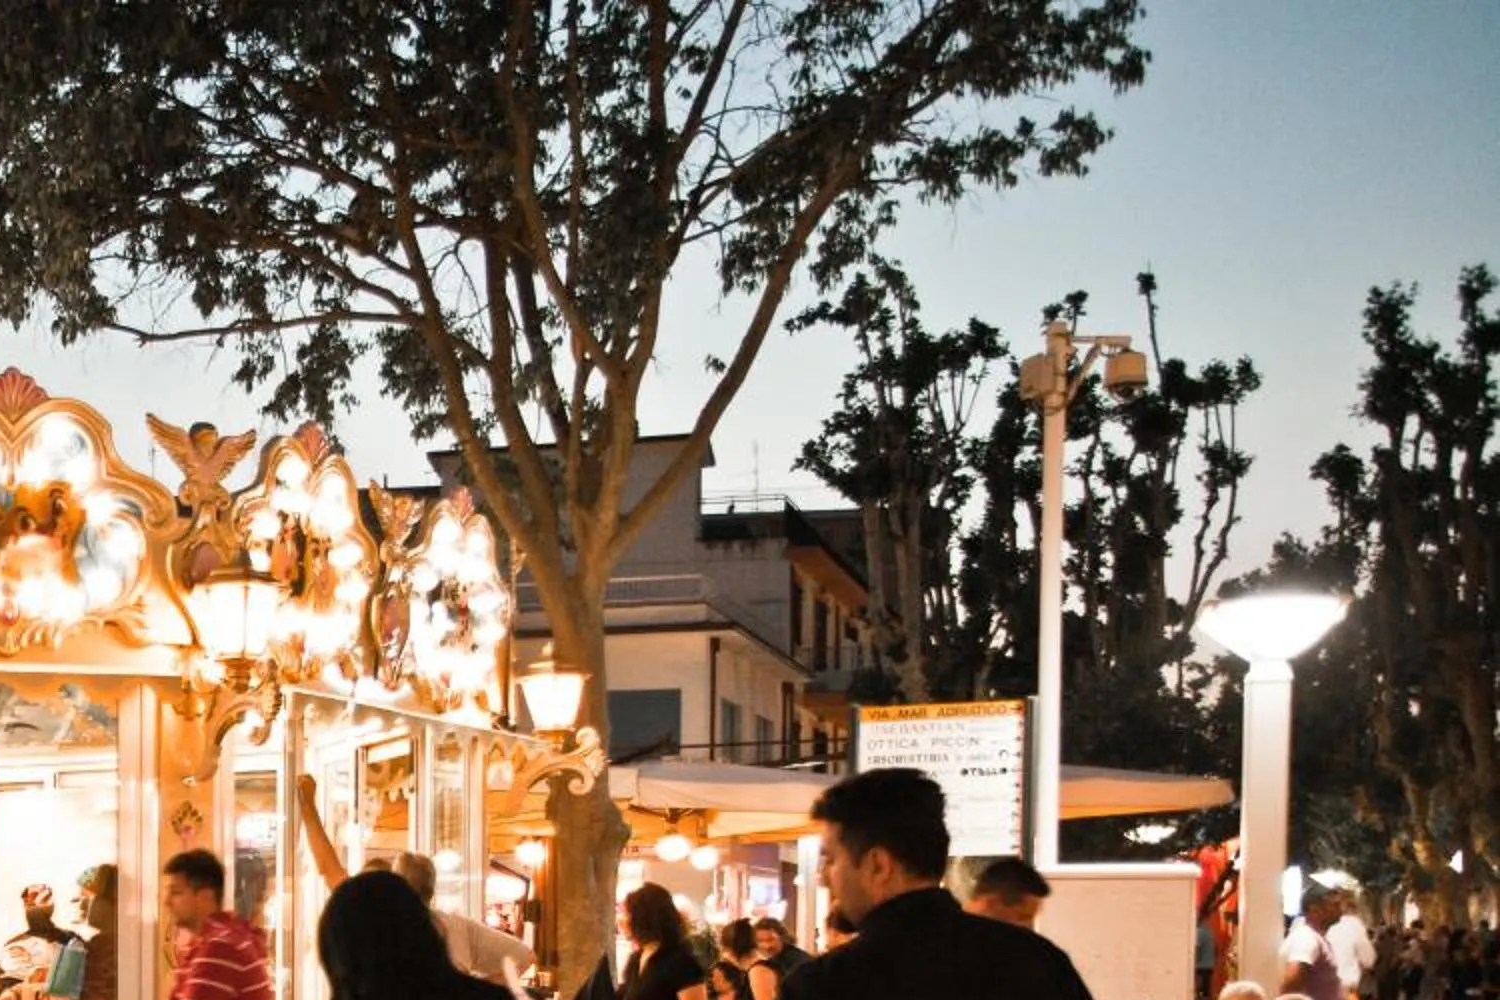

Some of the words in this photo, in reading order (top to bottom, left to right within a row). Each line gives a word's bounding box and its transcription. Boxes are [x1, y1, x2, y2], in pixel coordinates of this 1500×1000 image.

[868, 710, 890, 720] VIA
[898, 707, 927, 719] MAR
[867, 738, 920, 751] OTTICA
